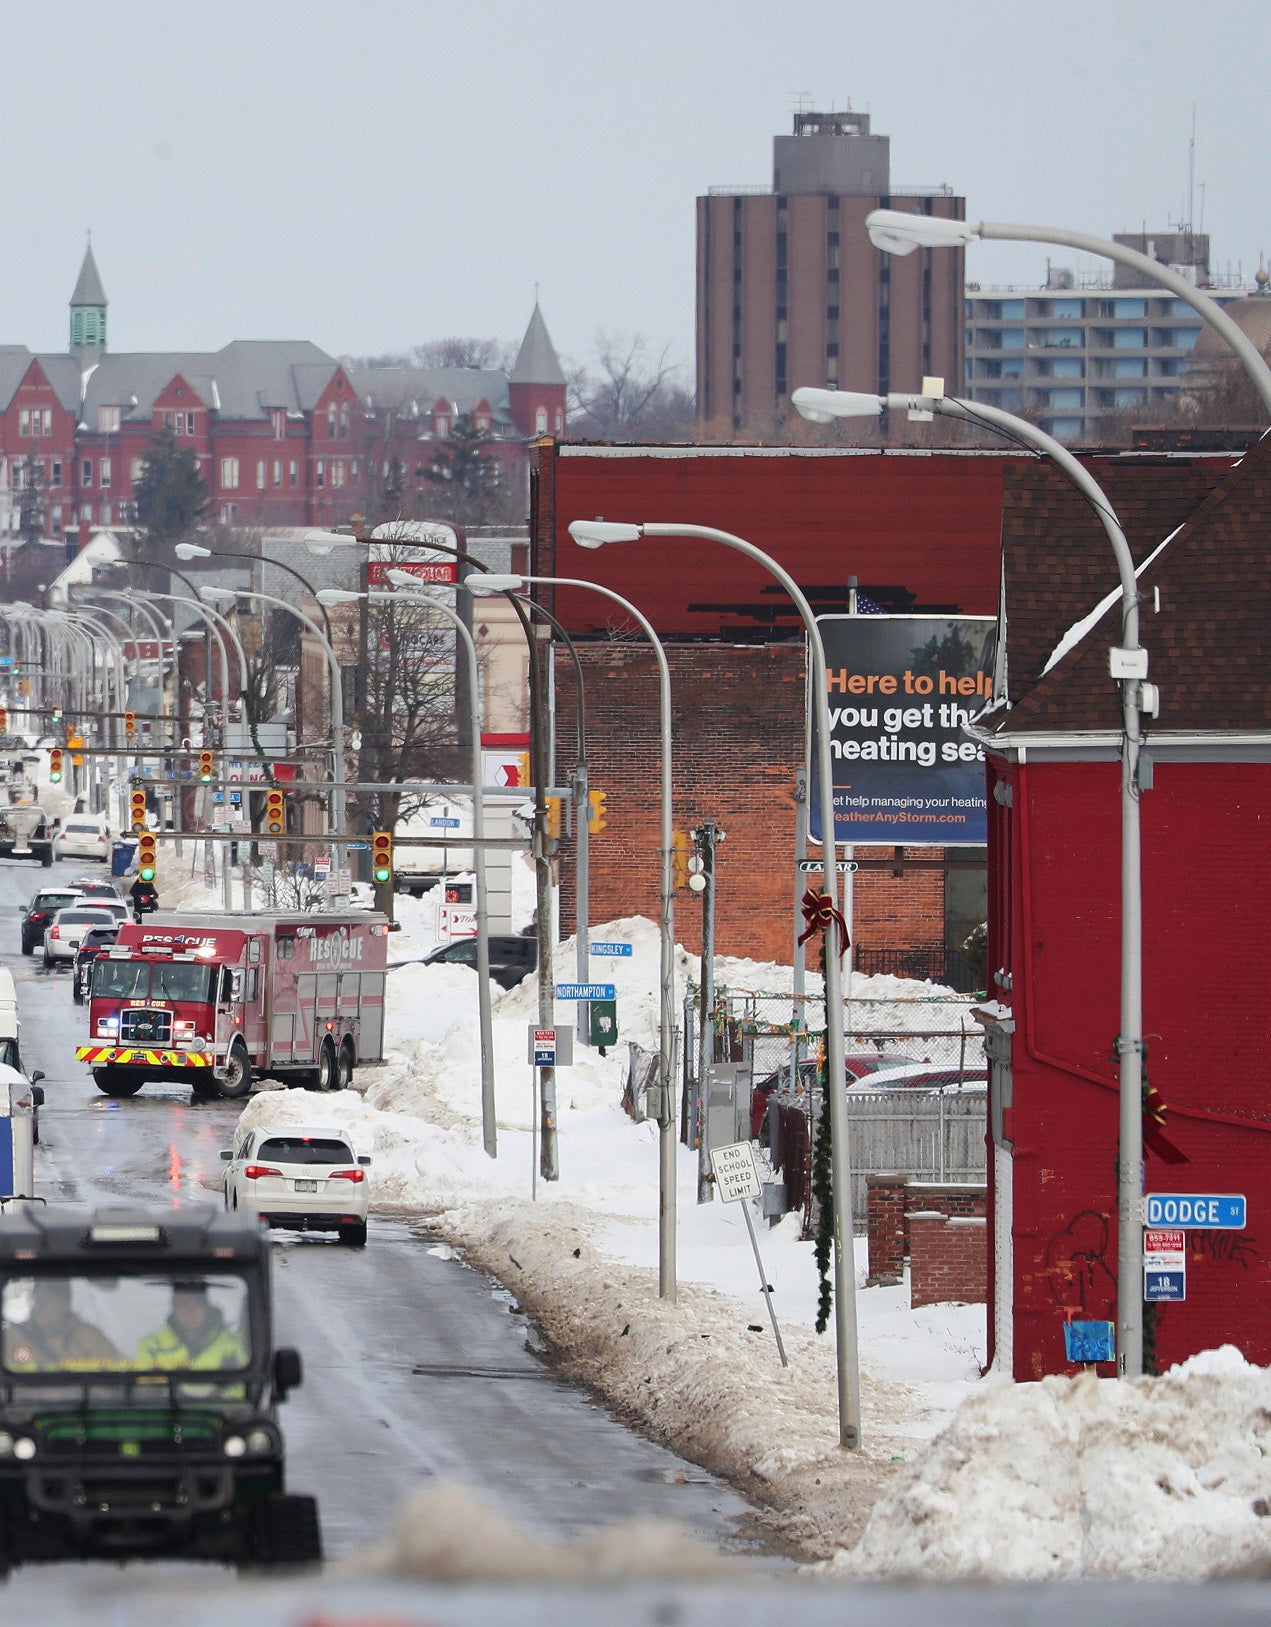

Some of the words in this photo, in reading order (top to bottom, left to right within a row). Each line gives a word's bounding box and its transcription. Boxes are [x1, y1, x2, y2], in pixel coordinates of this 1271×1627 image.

[826, 668, 898, 695] Here
[903, 670, 934, 695] to
[828, 707, 878, 733] you
[883, 703, 934, 733] get
[833, 795, 844, 806] et
[845, 795, 870, 808] help
[871, 797, 924, 809] managing
[925, 798, 950, 809] your
[833, 810, 966, 824] eatherAnyStorm.com
[805, 863, 852, 872] LAAR
[591, 943, 624, 955] KINGSLEY
[557, 986, 606, 998] NORTHAMPTON
[723, 1149, 741, 1160] END
[718, 1159, 752, 1174] SCHOOL
[723, 1171, 752, 1186] SPEED
[729, 1184, 751, 1198] LIMIT
[1149, 1200, 1220, 1223] DODGE
[1230, 1206, 1239, 1216] ST
[1157, 1276, 1171, 1286] 18
